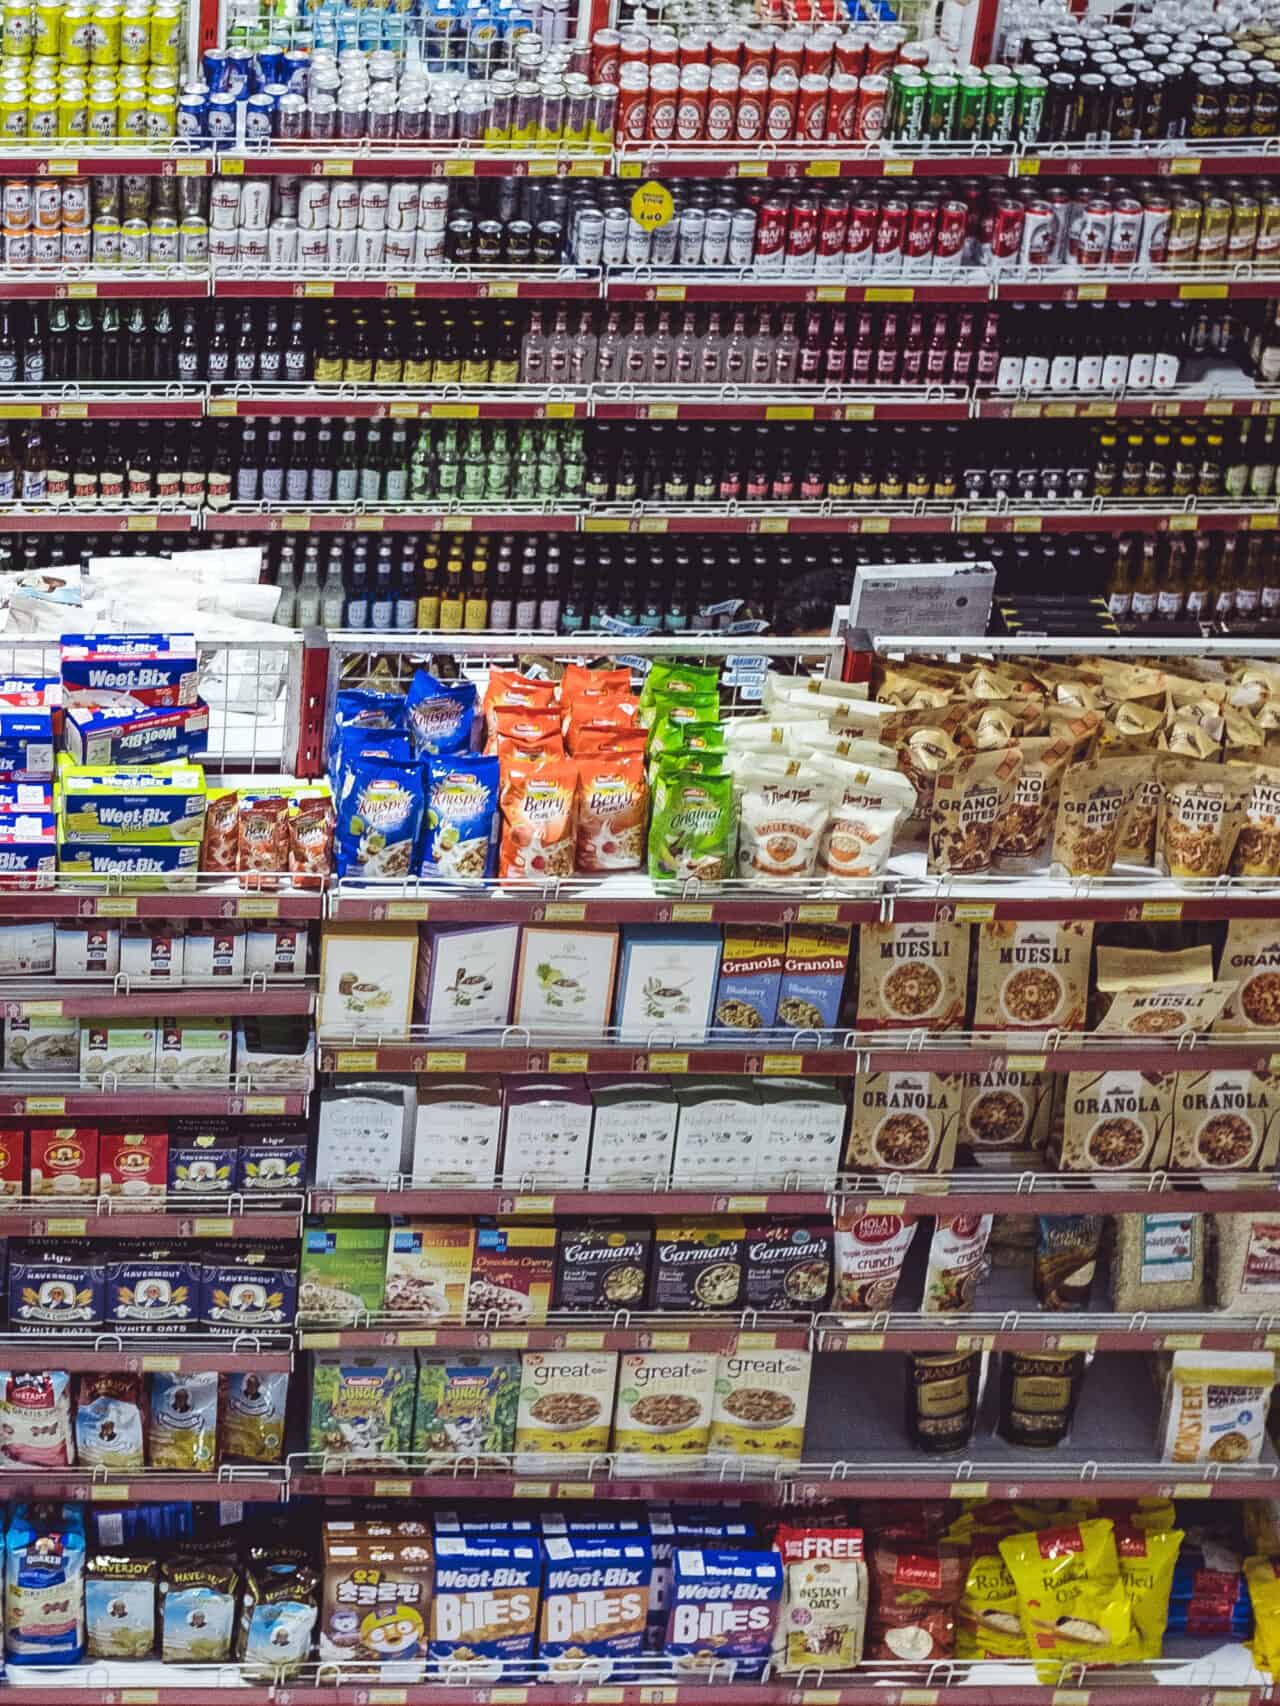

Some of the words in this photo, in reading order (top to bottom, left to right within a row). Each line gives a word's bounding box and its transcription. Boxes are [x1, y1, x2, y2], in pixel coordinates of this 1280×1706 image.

[88, 669, 171, 687] Weet-Bix
[523, 796, 565, 813] Berry
[590, 789, 635, 808] Berry
[99, 808, 171, 824] Weet-Bix
[961, 809, 996, 821] BITES
[1182, 810, 1219, 823] BITES
[94, 856, 165, 873] Weet-Bix
[880, 940, 950, 959] MUESLI
[1000, 947, 1071, 964] MUESLI
[722, 956, 781, 973] Granola
[784, 958, 844, 971] Granola
[1132, 997, 1205, 1009] MUESLI
[862, 1090, 949, 1110] GRANOLA
[1073, 1096, 1160, 1115] GRANOLA
[1182, 1092, 1270, 1110] GRANOLA
[43, 1253, 73, 1264] Ligo
[563, 1242, 643, 1263] Carman's
[659, 1241, 738, 1263] Carman's
[749, 1239, 828, 1262] Carman's
[857, 1257, 896, 1270] crunch
[26, 1271, 86, 1282] HAVERMOUT
[123, 1271, 180, 1280] HAVERMOUT
[219, 1275, 277, 1284] HAVERMOUT
[114, 1324, 153, 1334] WHITE
[157, 1325, 187, 1334] OATS
[532, 1363, 591, 1386] great
[633, 1364, 691, 1387] great
[726, 1357, 784, 1378] great
[802, 1537, 863, 1559] FREE
[436, 1567, 530, 1588] Weet-Bix
[549, 1568, 642, 1589] Weet-Bix
[677, 1582, 773, 1600] Weet-Bix
[799, 1586, 848, 1599] INSTANT
[809, 1598, 841, 1611] OATS
